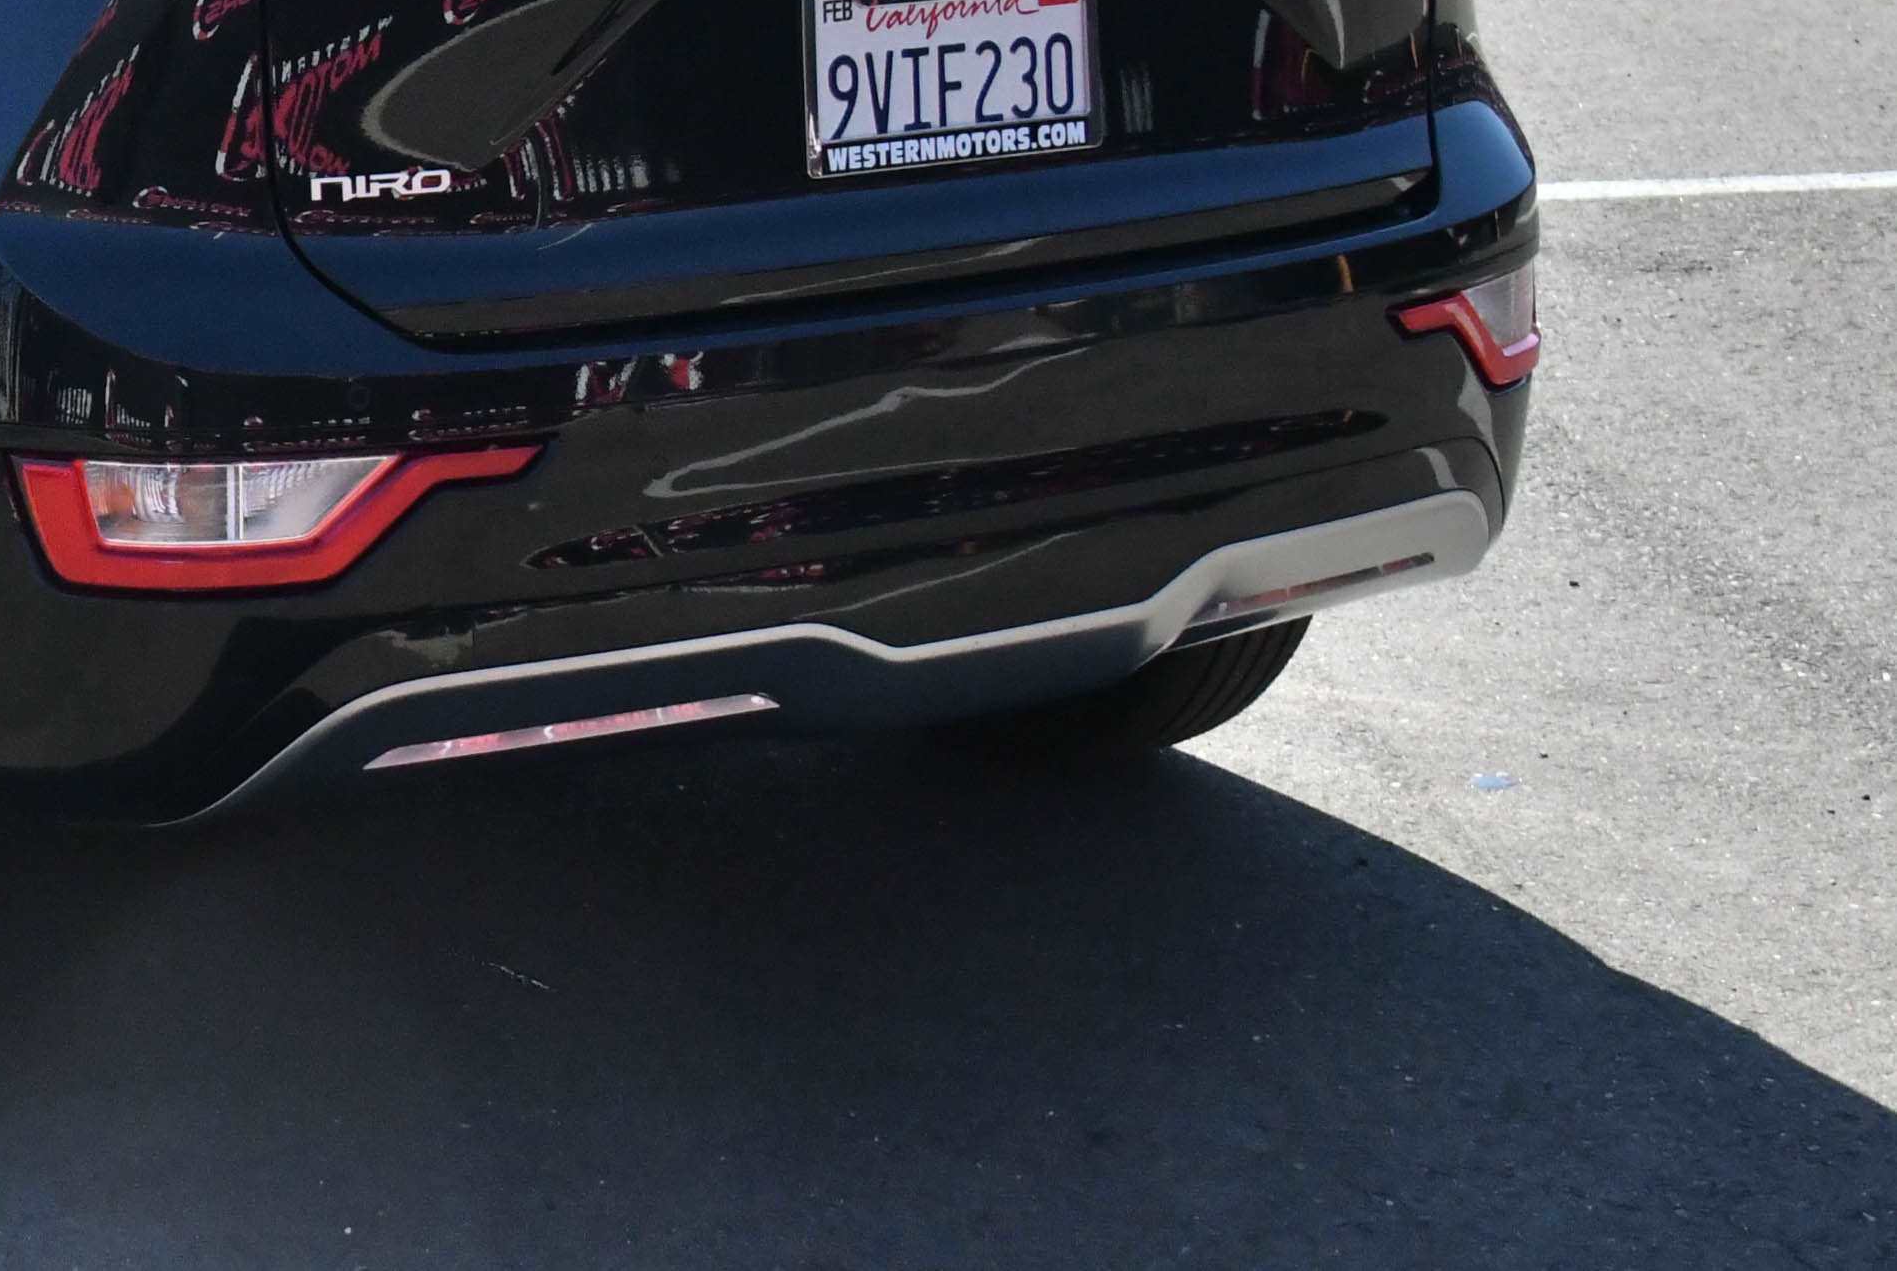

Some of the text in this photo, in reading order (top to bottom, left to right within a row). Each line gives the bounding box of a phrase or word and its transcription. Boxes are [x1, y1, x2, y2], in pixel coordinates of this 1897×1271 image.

[823, 0, 853, 23] FEB
[828, 32, 1074, 141] 9VIF230
[827, 121, 1086, 172] WESTERNMOTORS.COM
[310, 169, 451, 202] NIRO
